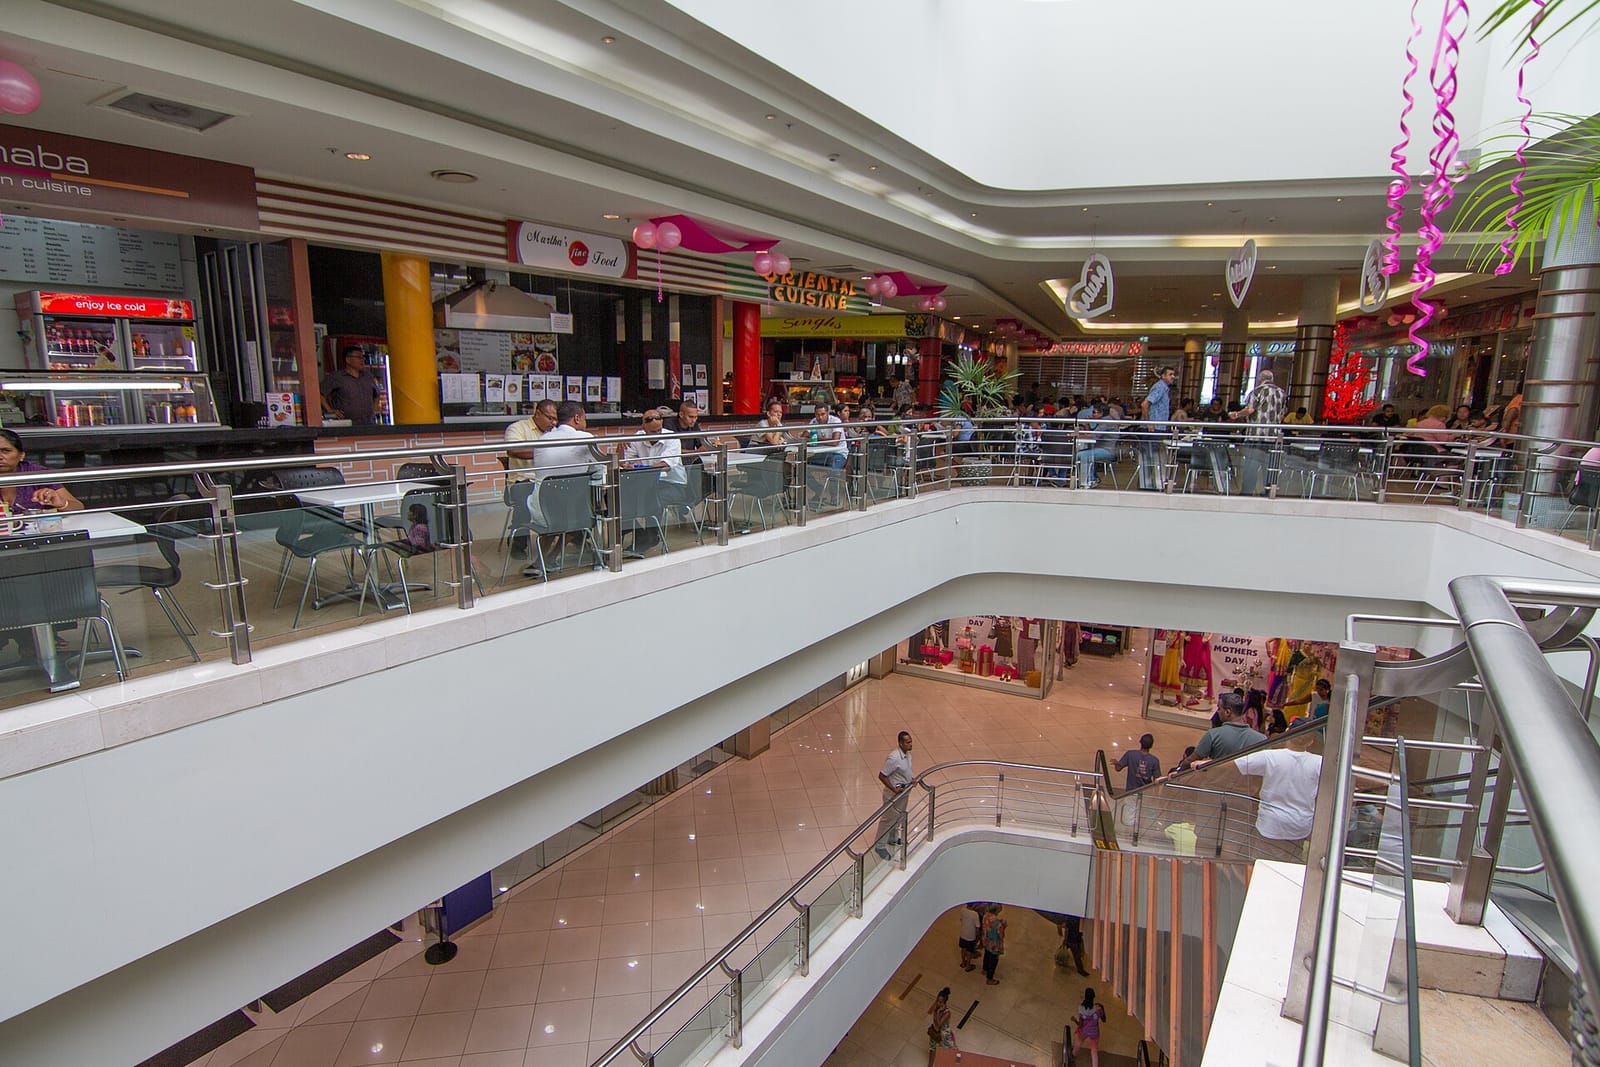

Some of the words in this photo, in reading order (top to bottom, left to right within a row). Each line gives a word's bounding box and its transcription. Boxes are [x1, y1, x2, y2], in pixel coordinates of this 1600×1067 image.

[22, 178, 92, 196] cuisine
[526, 231, 568, 247] Martha's
[591, 251, 618, 267] Food
[774, 286, 848, 311] CUISINE
[75, 301, 104, 311] enjoy
[107, 301, 122, 310] ice
[123, 303, 146, 312] cold
[1127, 341, 1143, 356] 88
[968, 619, 984, 627] DAY
[1221, 636, 1253, 646] HAPPY
[1213, 645, 1259, 657] MOTHERS
[1224, 656, 1245, 665] DAY
